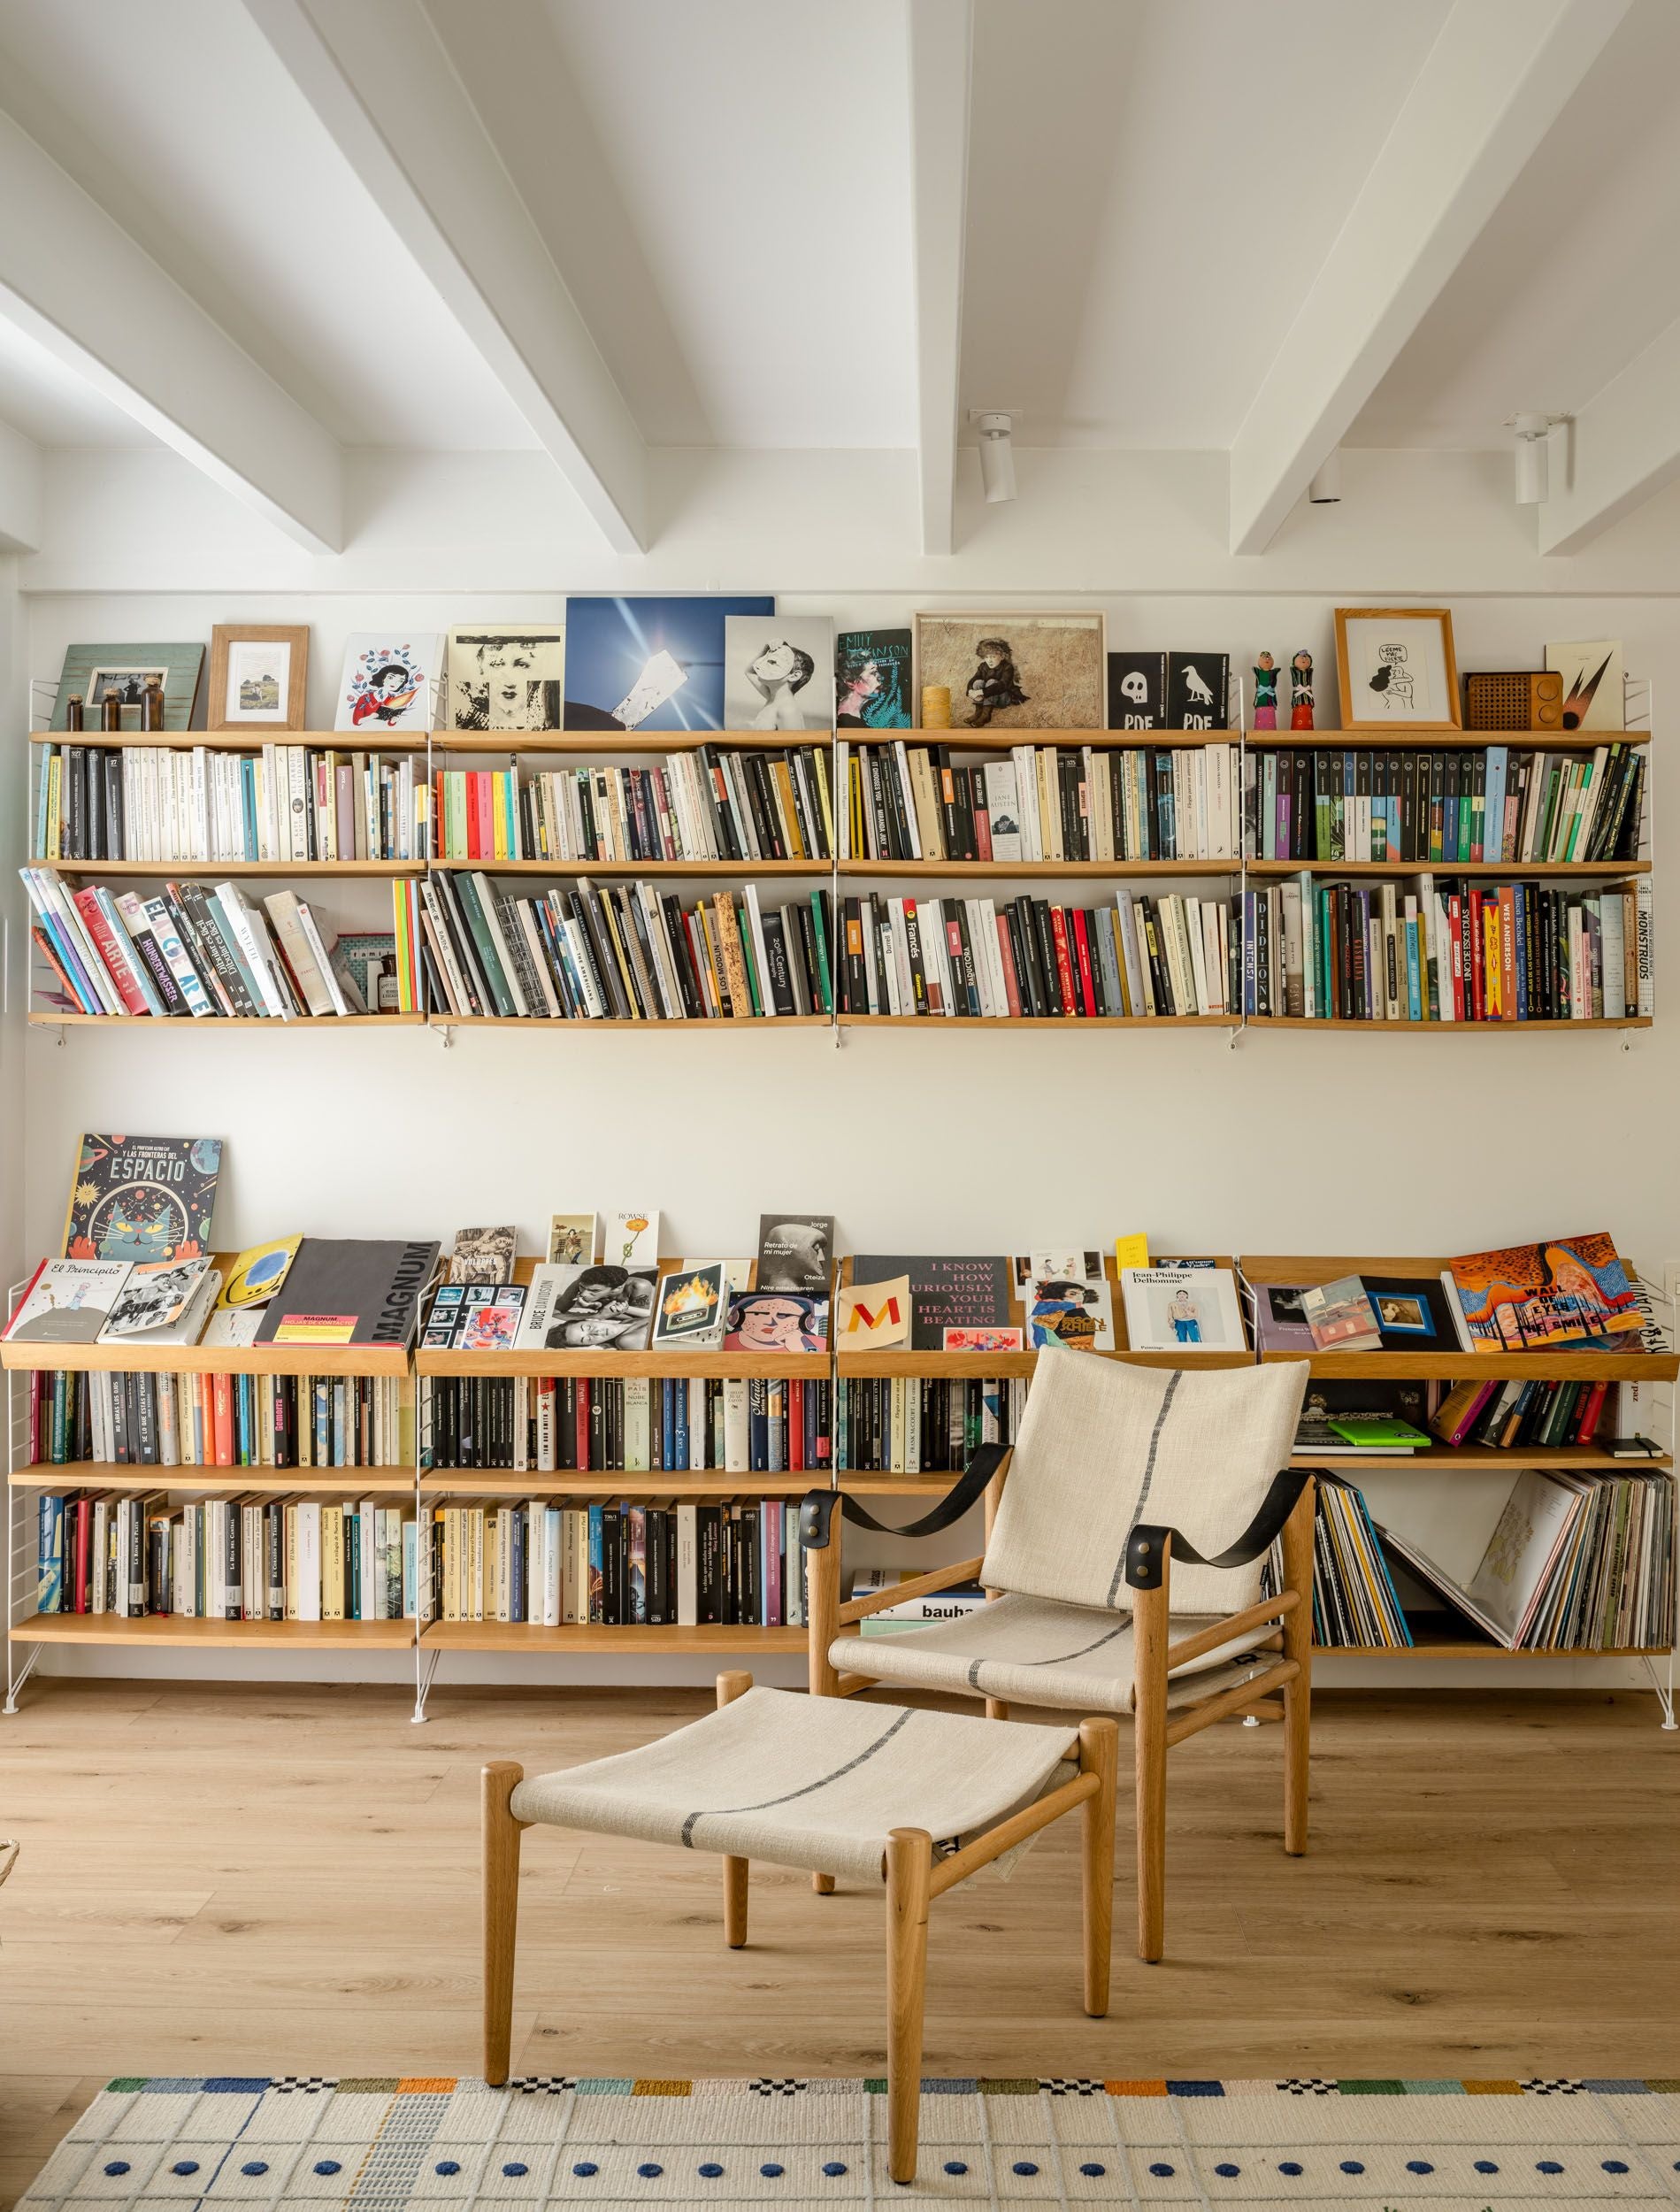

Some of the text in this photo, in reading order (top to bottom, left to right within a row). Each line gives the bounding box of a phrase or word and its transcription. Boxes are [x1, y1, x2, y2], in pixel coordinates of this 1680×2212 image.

[573, 899, 608, 1010] SALLY MANN IMMEDIATE FAMILY APERTURE
[908, 922, 919, 958] Francés
[1463, 950, 1471, 961] DE
[1638, 910, 1648, 979] MONSTRUOS
[103, 940, 130, 979] ARTE
[142, 939, 179, 1002] HUNDERTWASSER
[713, 945, 727, 991] LOS MODLIN
[769, 949, 778, 978] Photography
[772, 938, 786, 987] 20th Century
[1354, 939, 1363, 981] GASOLINA
[579, 966, 593, 1001] AMERICANS
[1291, 983, 1300, 1011] LA SED
[110, 1157, 186, 1181] ESPACIO
[51, 1264, 121, 1277] El Principito
[370, 1241, 438, 1341] MAGNUM
[530, 1279, 555, 1330] BRUCE DAVIDSON
[1524, 1286, 1567, 1296] WALL
[1533, 1302, 1569, 1314] EYES
[1553, 1316, 1600, 1330] SMILE
